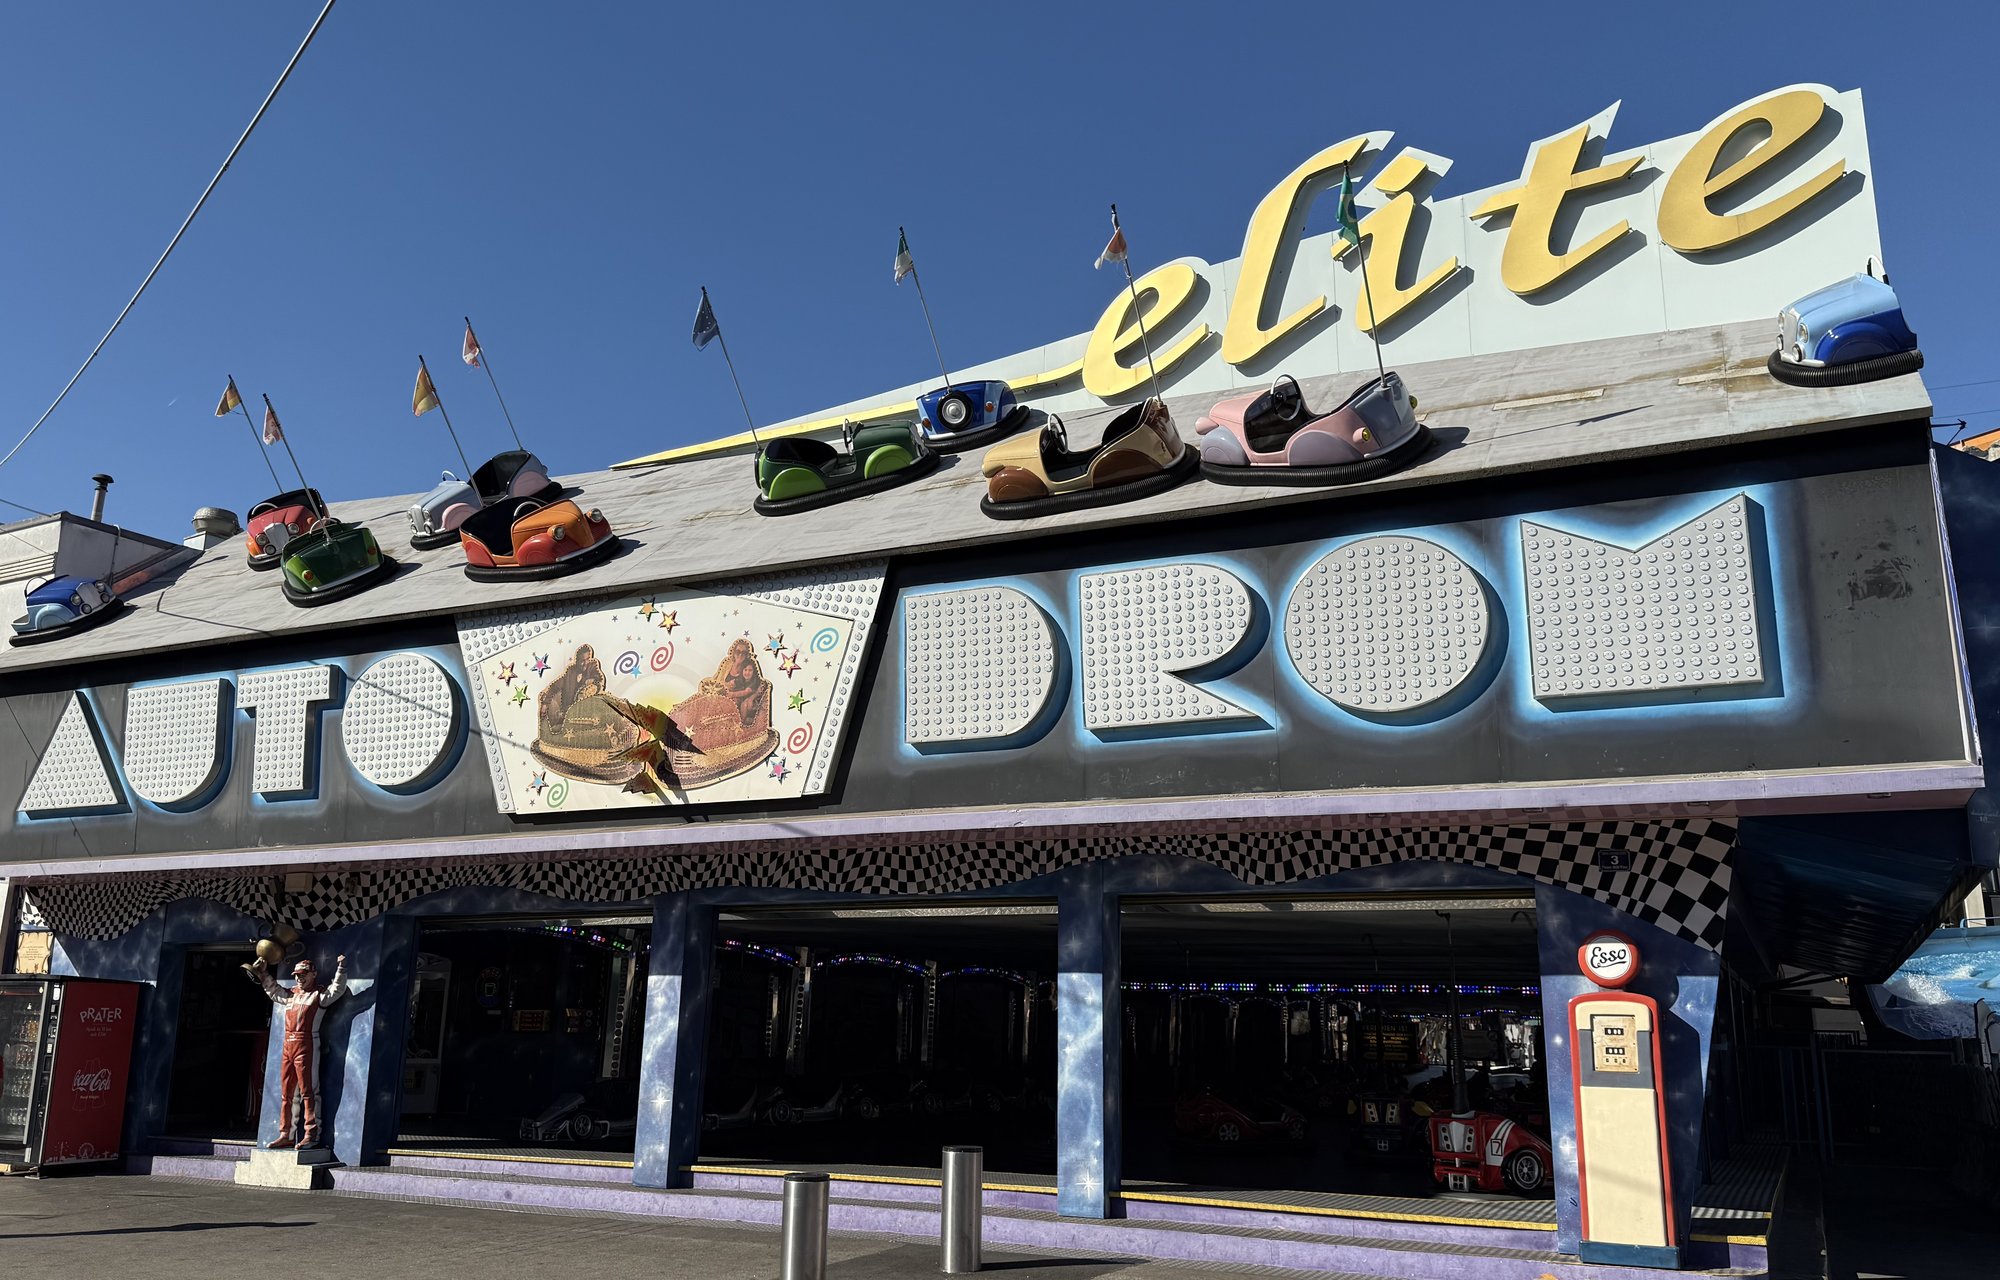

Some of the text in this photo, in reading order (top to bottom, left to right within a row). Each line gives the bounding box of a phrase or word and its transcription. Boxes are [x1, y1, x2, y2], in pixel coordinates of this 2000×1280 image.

[1083, 91, 1846, 397] elite
[17, 492, 1766, 812] AUTO DROM
[1610, 855, 1619, 865] 3
[1590, 946, 1627, 969] Esso
[80, 1008, 122, 1023] PRATER
[1492, 1141, 1501, 1153] 7
